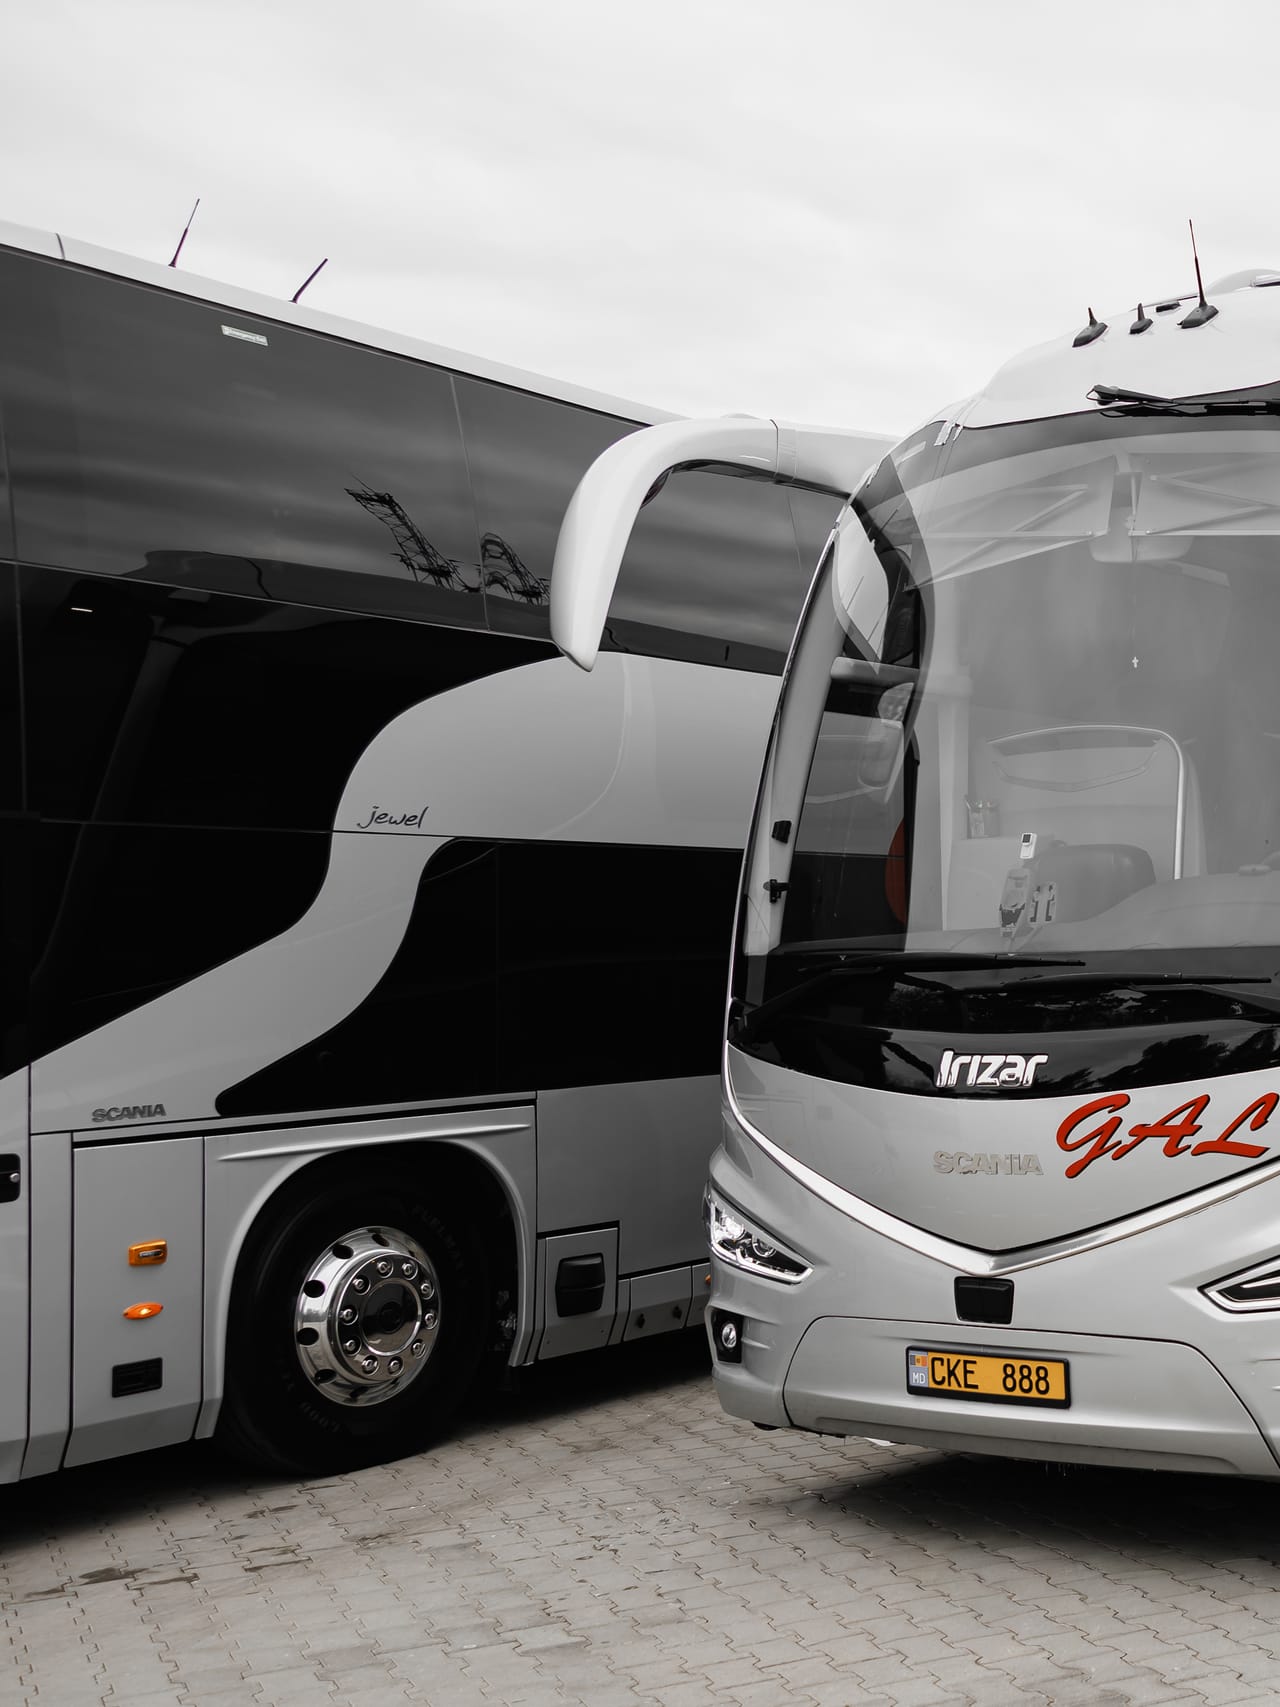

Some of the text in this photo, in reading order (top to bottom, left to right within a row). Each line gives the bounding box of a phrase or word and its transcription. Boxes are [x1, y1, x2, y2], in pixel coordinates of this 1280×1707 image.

[357, 805, 430, 829] jewel
[936, 1048, 1049, 1088] Irizar
[92, 1103, 167, 1123] SCANIA
[1056, 1092, 1280, 1179] GAL
[933, 1150, 1044, 1176] SCANIA
[912, 1371, 927, 1385] MD
[930, 1356, 1050, 1396] CKE 888
